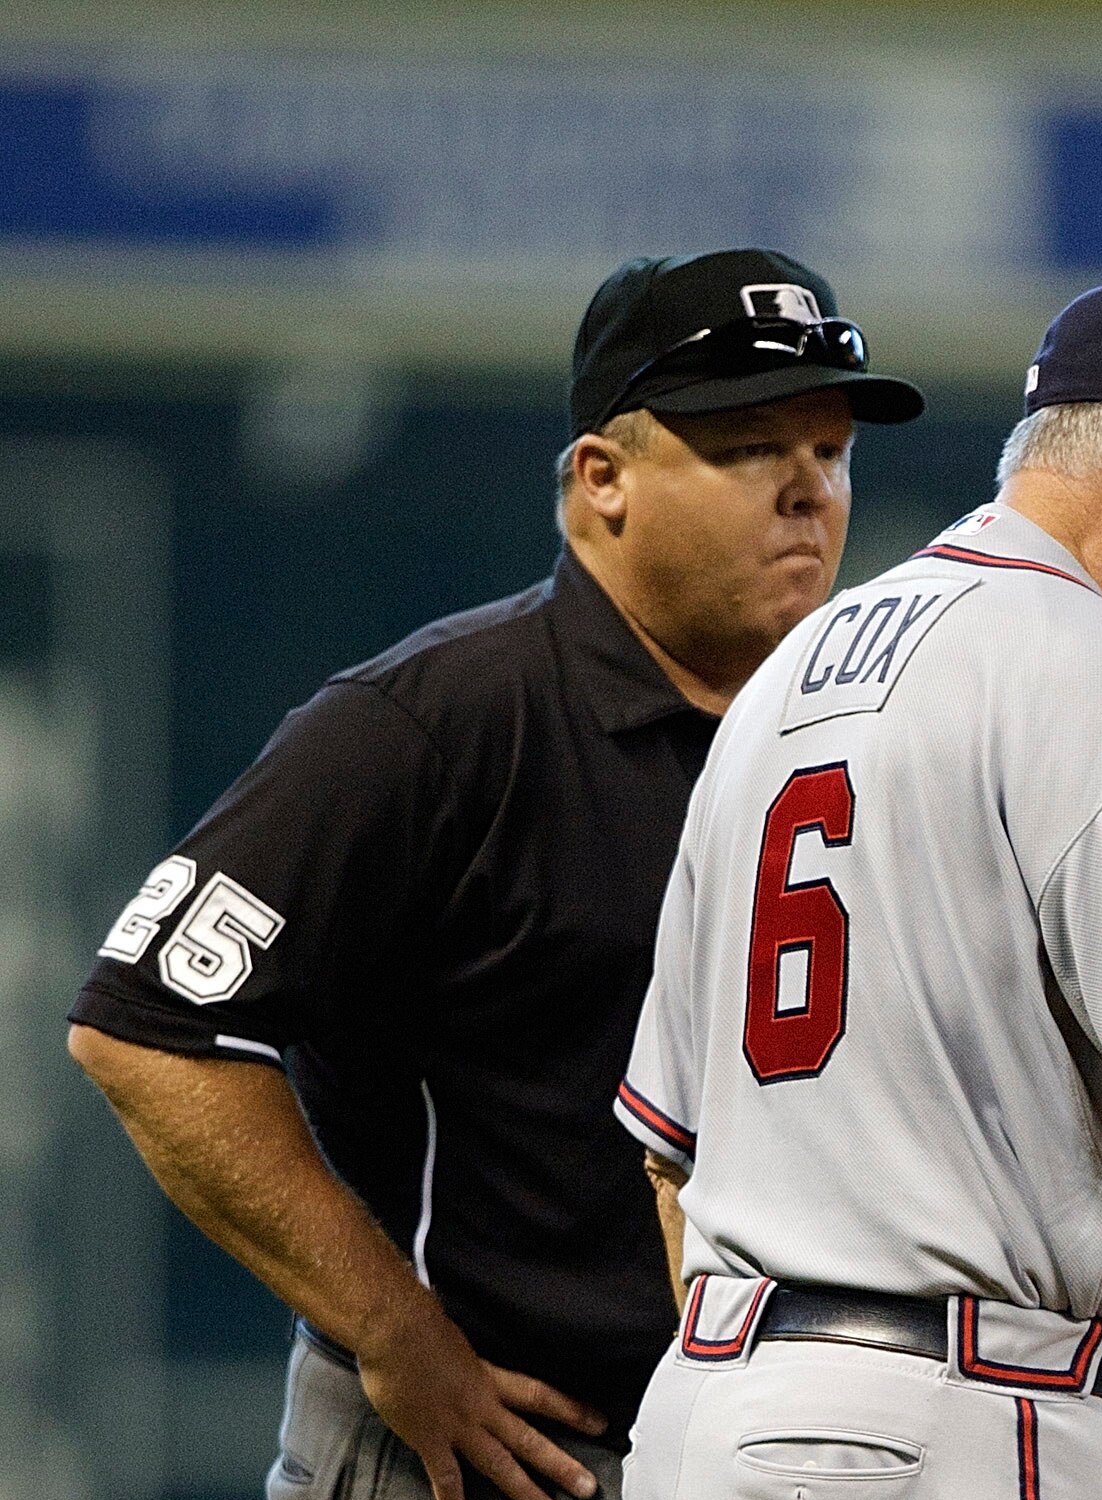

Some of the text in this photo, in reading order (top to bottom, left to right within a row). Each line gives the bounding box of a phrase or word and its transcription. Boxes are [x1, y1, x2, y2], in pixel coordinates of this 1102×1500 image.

[800, 594, 943, 695] COX
[97, 854, 287, 1006] 25
[742, 759, 856, 1087] 6
